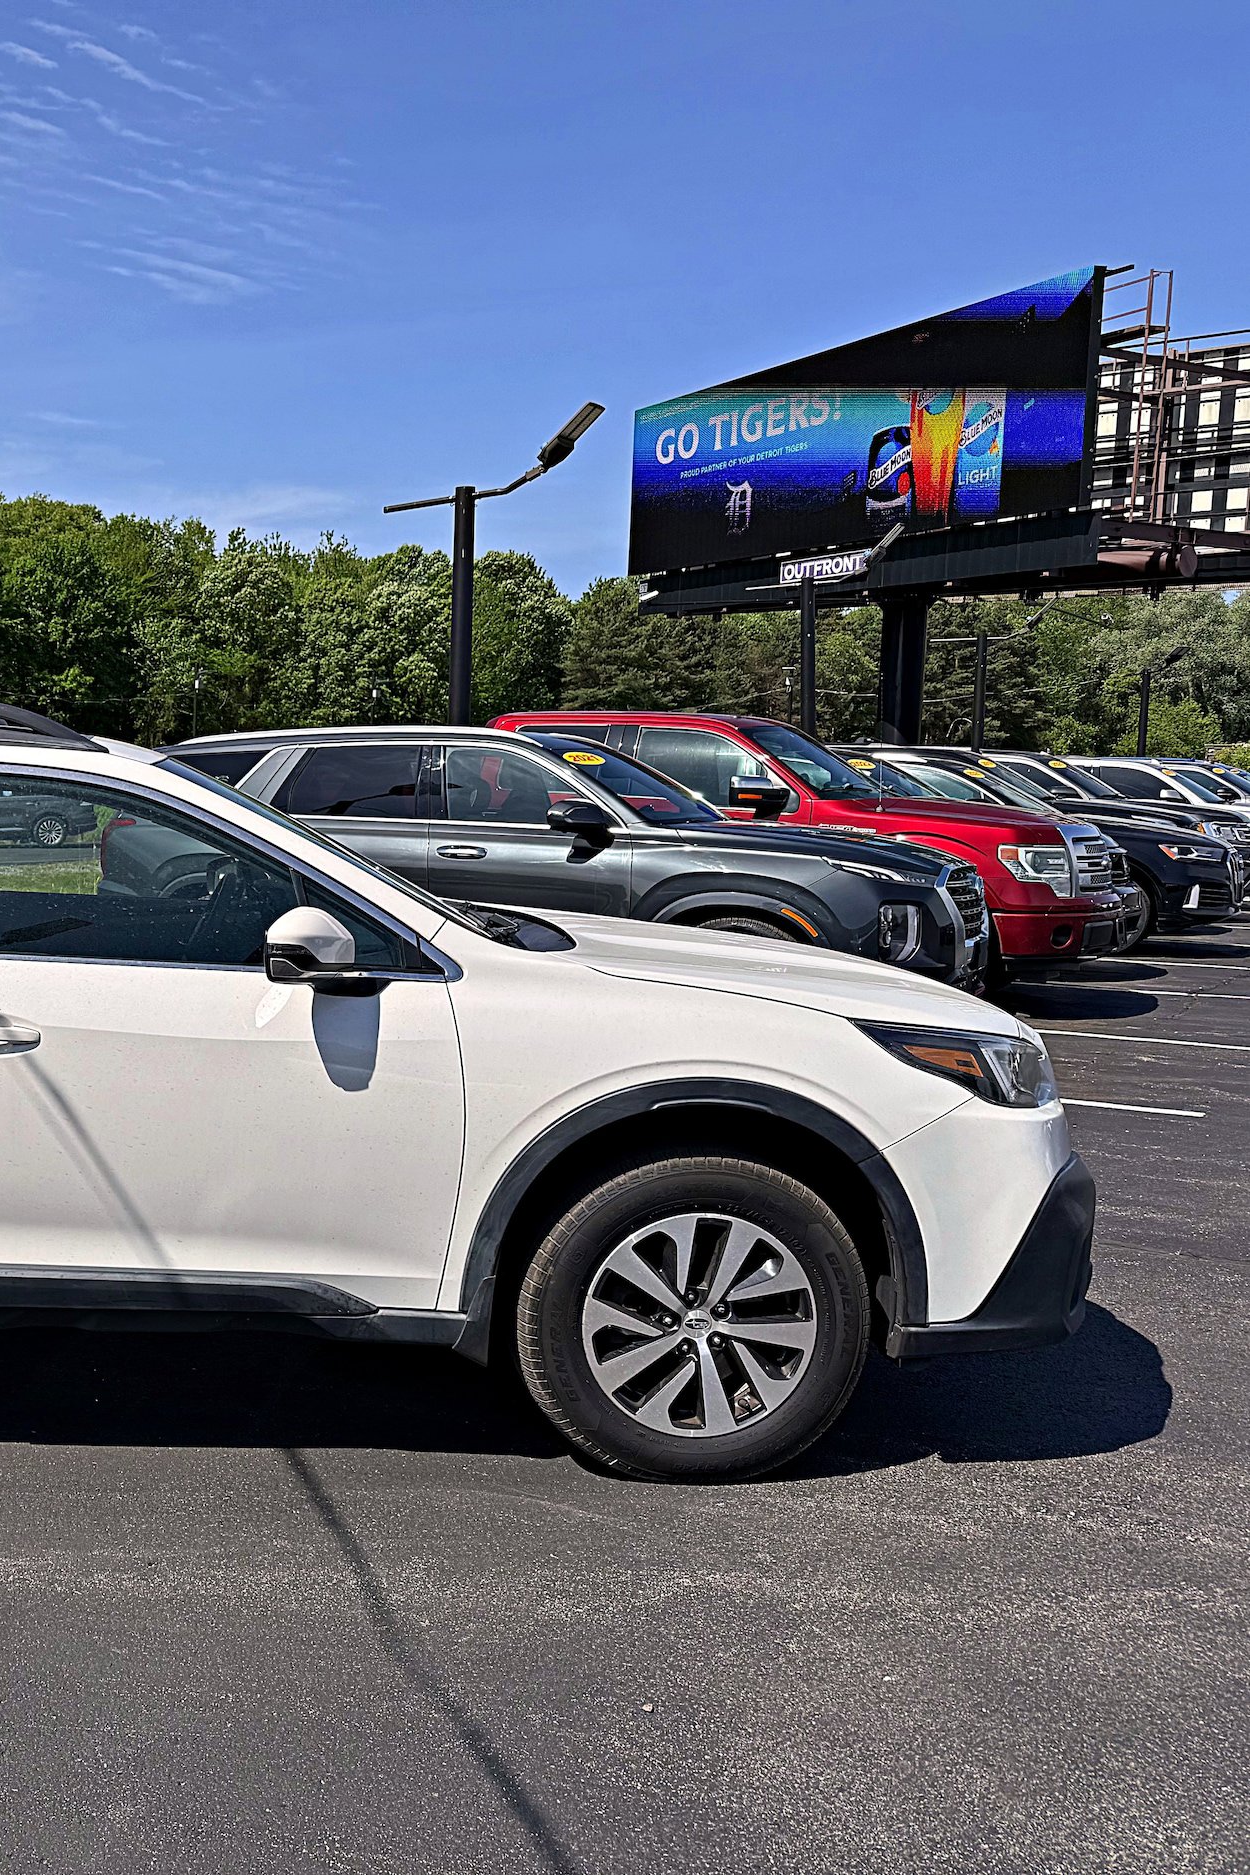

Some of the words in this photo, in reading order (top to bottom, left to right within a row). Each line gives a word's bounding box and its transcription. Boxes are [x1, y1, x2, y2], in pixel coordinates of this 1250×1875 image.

[655, 422, 700, 465] GO
[708, 393, 842, 451] TIGERS!
[959, 424, 981, 447] BLUE
[981, 408, 1003, 431] MOON
[680, 468, 700, 480] PROUD
[700, 461, 728, 474] PARTNER
[728, 458, 738, 468] OF
[738, 453, 756, 466] YOUR
[756, 447, 784, 461] DETROIT
[785, 441, 809, 454] TIGERS
[958, 465, 999, 486] LIGHT
[868, 466, 890, 488] BLUE
[783, 554, 866, 580] OUTFRONT
